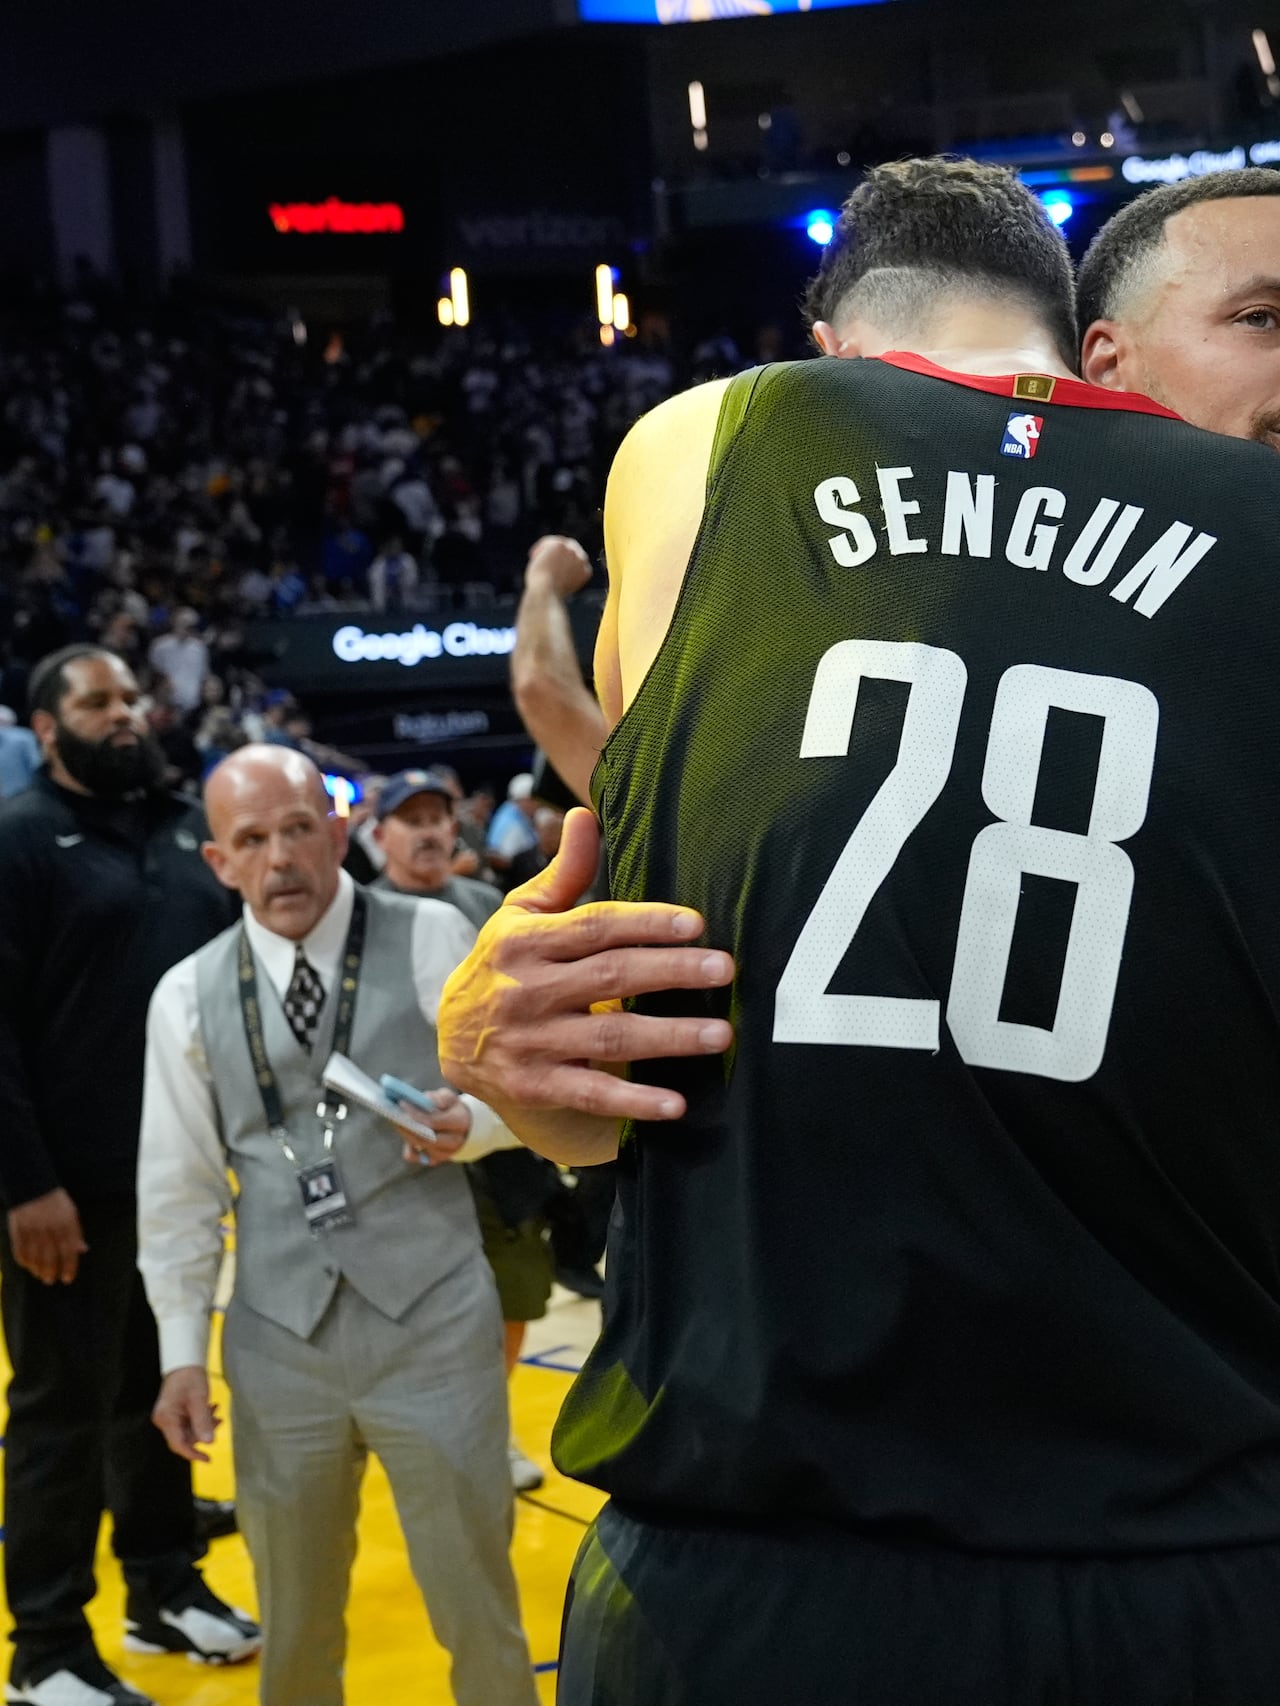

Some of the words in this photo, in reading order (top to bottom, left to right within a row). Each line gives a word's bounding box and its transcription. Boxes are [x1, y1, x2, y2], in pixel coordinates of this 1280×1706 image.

[1004, 442, 1024, 455] NBA
[813, 464, 1218, 620] SENGUN
[332, 622, 443, 667] Google
[442, 621, 517, 657] Clou
[772, 638, 1160, 1083] 28
